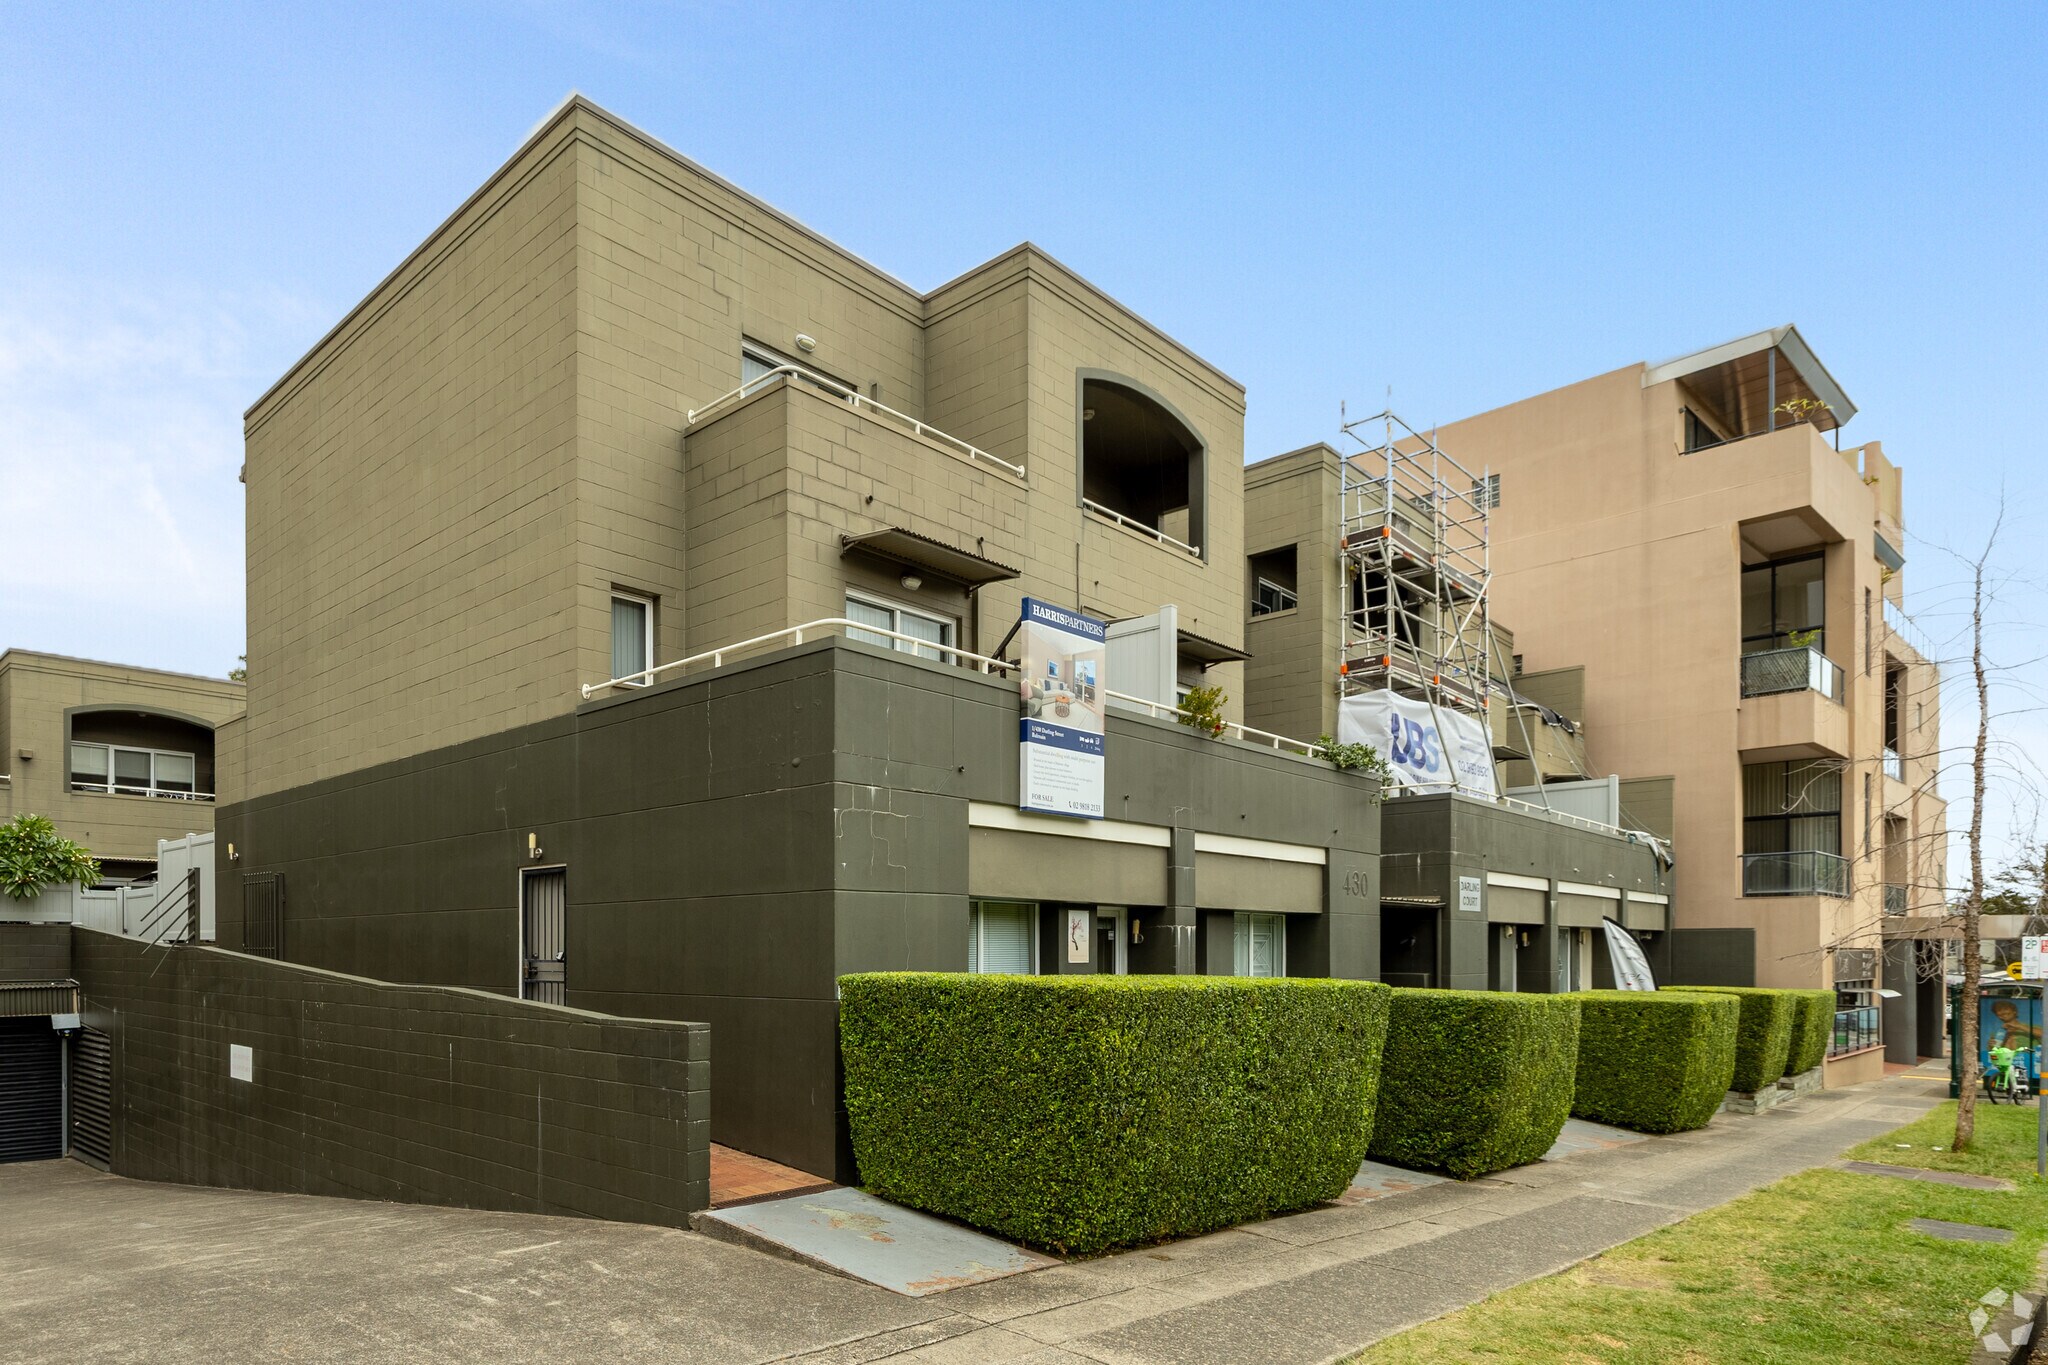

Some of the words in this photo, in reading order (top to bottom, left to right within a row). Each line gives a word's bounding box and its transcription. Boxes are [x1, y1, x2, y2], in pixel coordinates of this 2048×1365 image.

[1032, 604, 1104, 637] HARRISPARTNERS
[1390, 712, 1440, 774] UBS
[1031, 793, 1042, 801] FOR
[1042, 794, 1055, 802] SALE
[1073, 801, 1079, 810] 02
[1342, 870, 1369, 898] 430
[1460, 881, 1480, 893] DARLING
[1462, 896, 1478, 907] COURT
[2025, 939, 2038, 950] 2P
